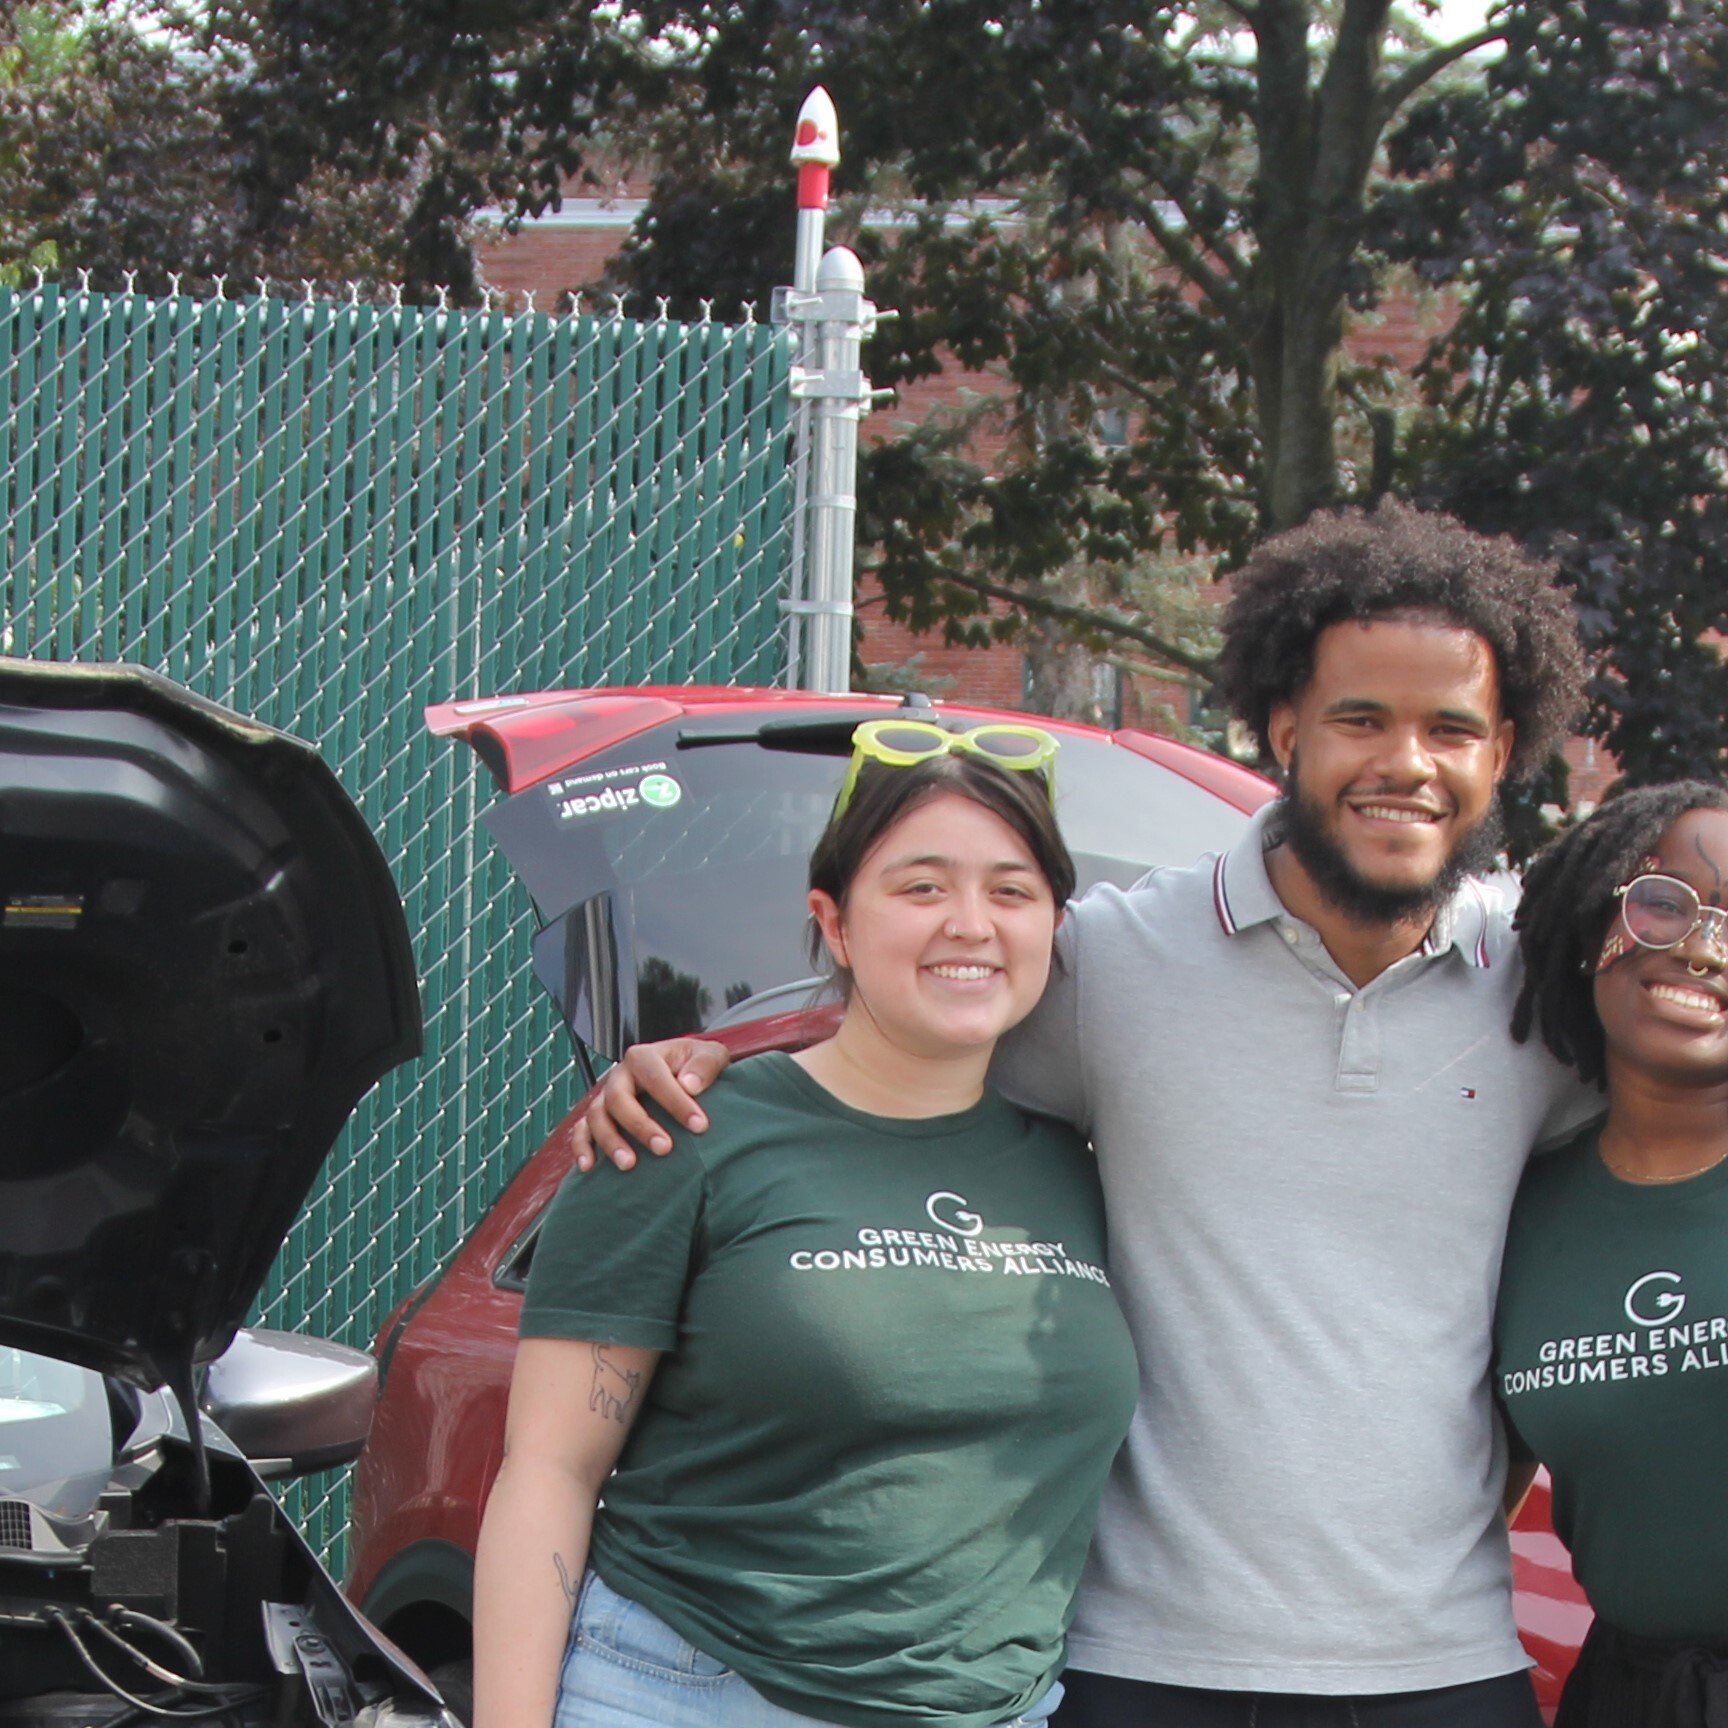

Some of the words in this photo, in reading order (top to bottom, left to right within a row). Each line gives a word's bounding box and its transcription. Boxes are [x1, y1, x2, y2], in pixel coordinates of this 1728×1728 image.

[605, 770, 618, 778] on
[619, 766, 640, 775] cars
[641, 761, 667, 773] Book
[564, 772, 604, 787] demand
[858, 1227, 959, 1252] GREEN
[965, 1239, 1067, 1258] ENERGY
[789, 1248, 994, 1273] CONSUMERS
[1538, 1332, 1637, 1363] GREEN
[1503, 1353, 1669, 1396] CONSUMERS
